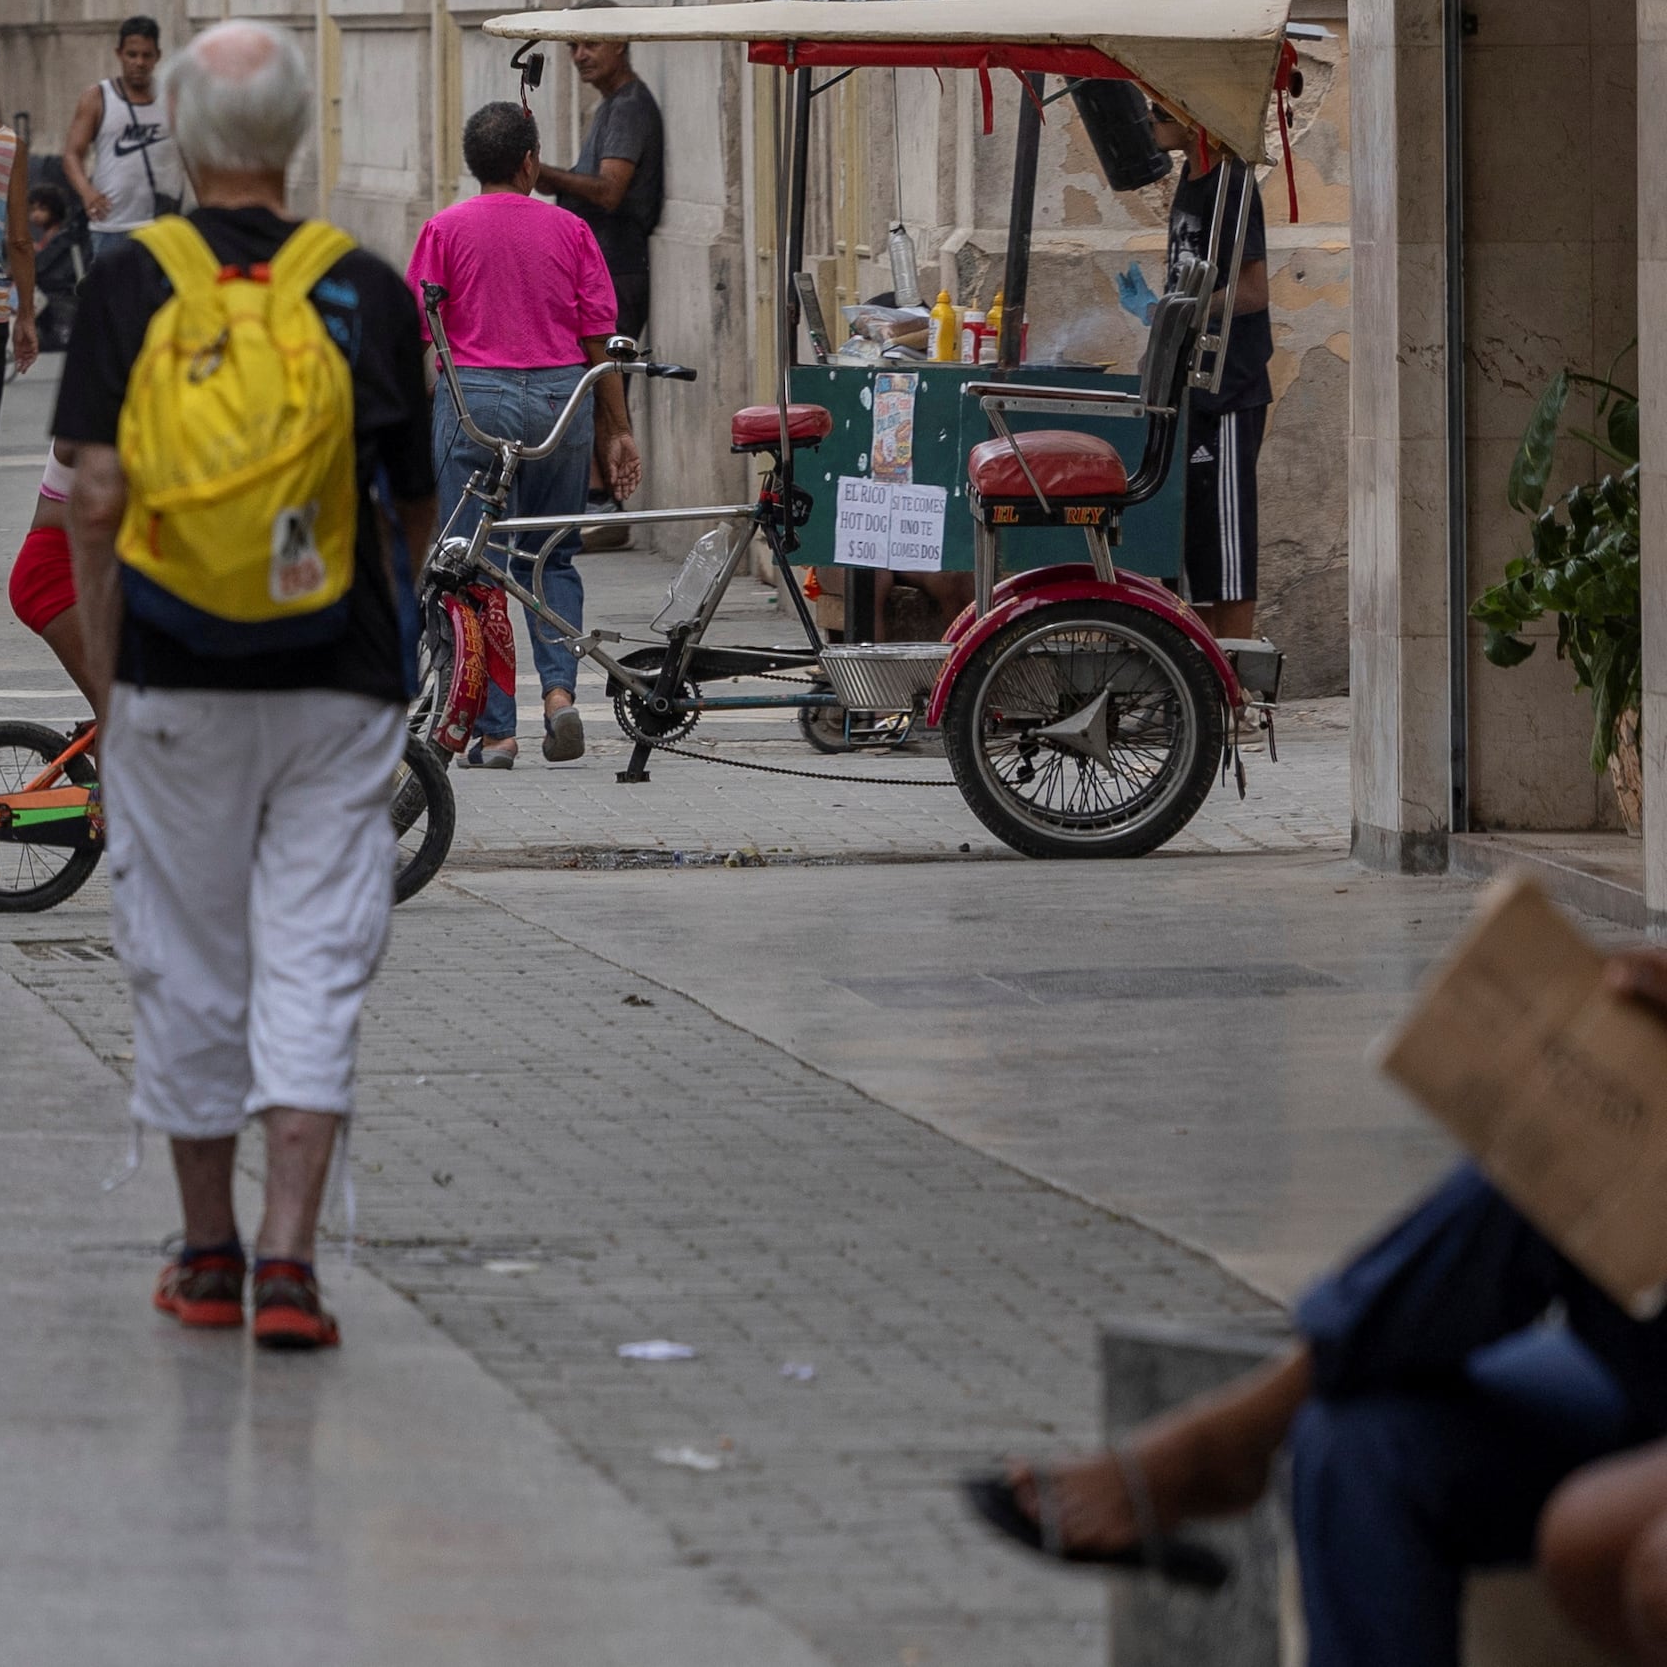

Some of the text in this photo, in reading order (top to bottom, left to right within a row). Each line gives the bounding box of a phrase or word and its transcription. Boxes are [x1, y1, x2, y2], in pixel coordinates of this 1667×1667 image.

[845, 484, 886, 504] EL RICO
[892, 496, 945, 513] SI TE COMES
[840, 511, 887, 533] HOT DOG
[992, 505, 1105, 524] EL REY
[900, 519, 933, 536] UNO TE
[891, 542, 940, 560] COMES DOS
